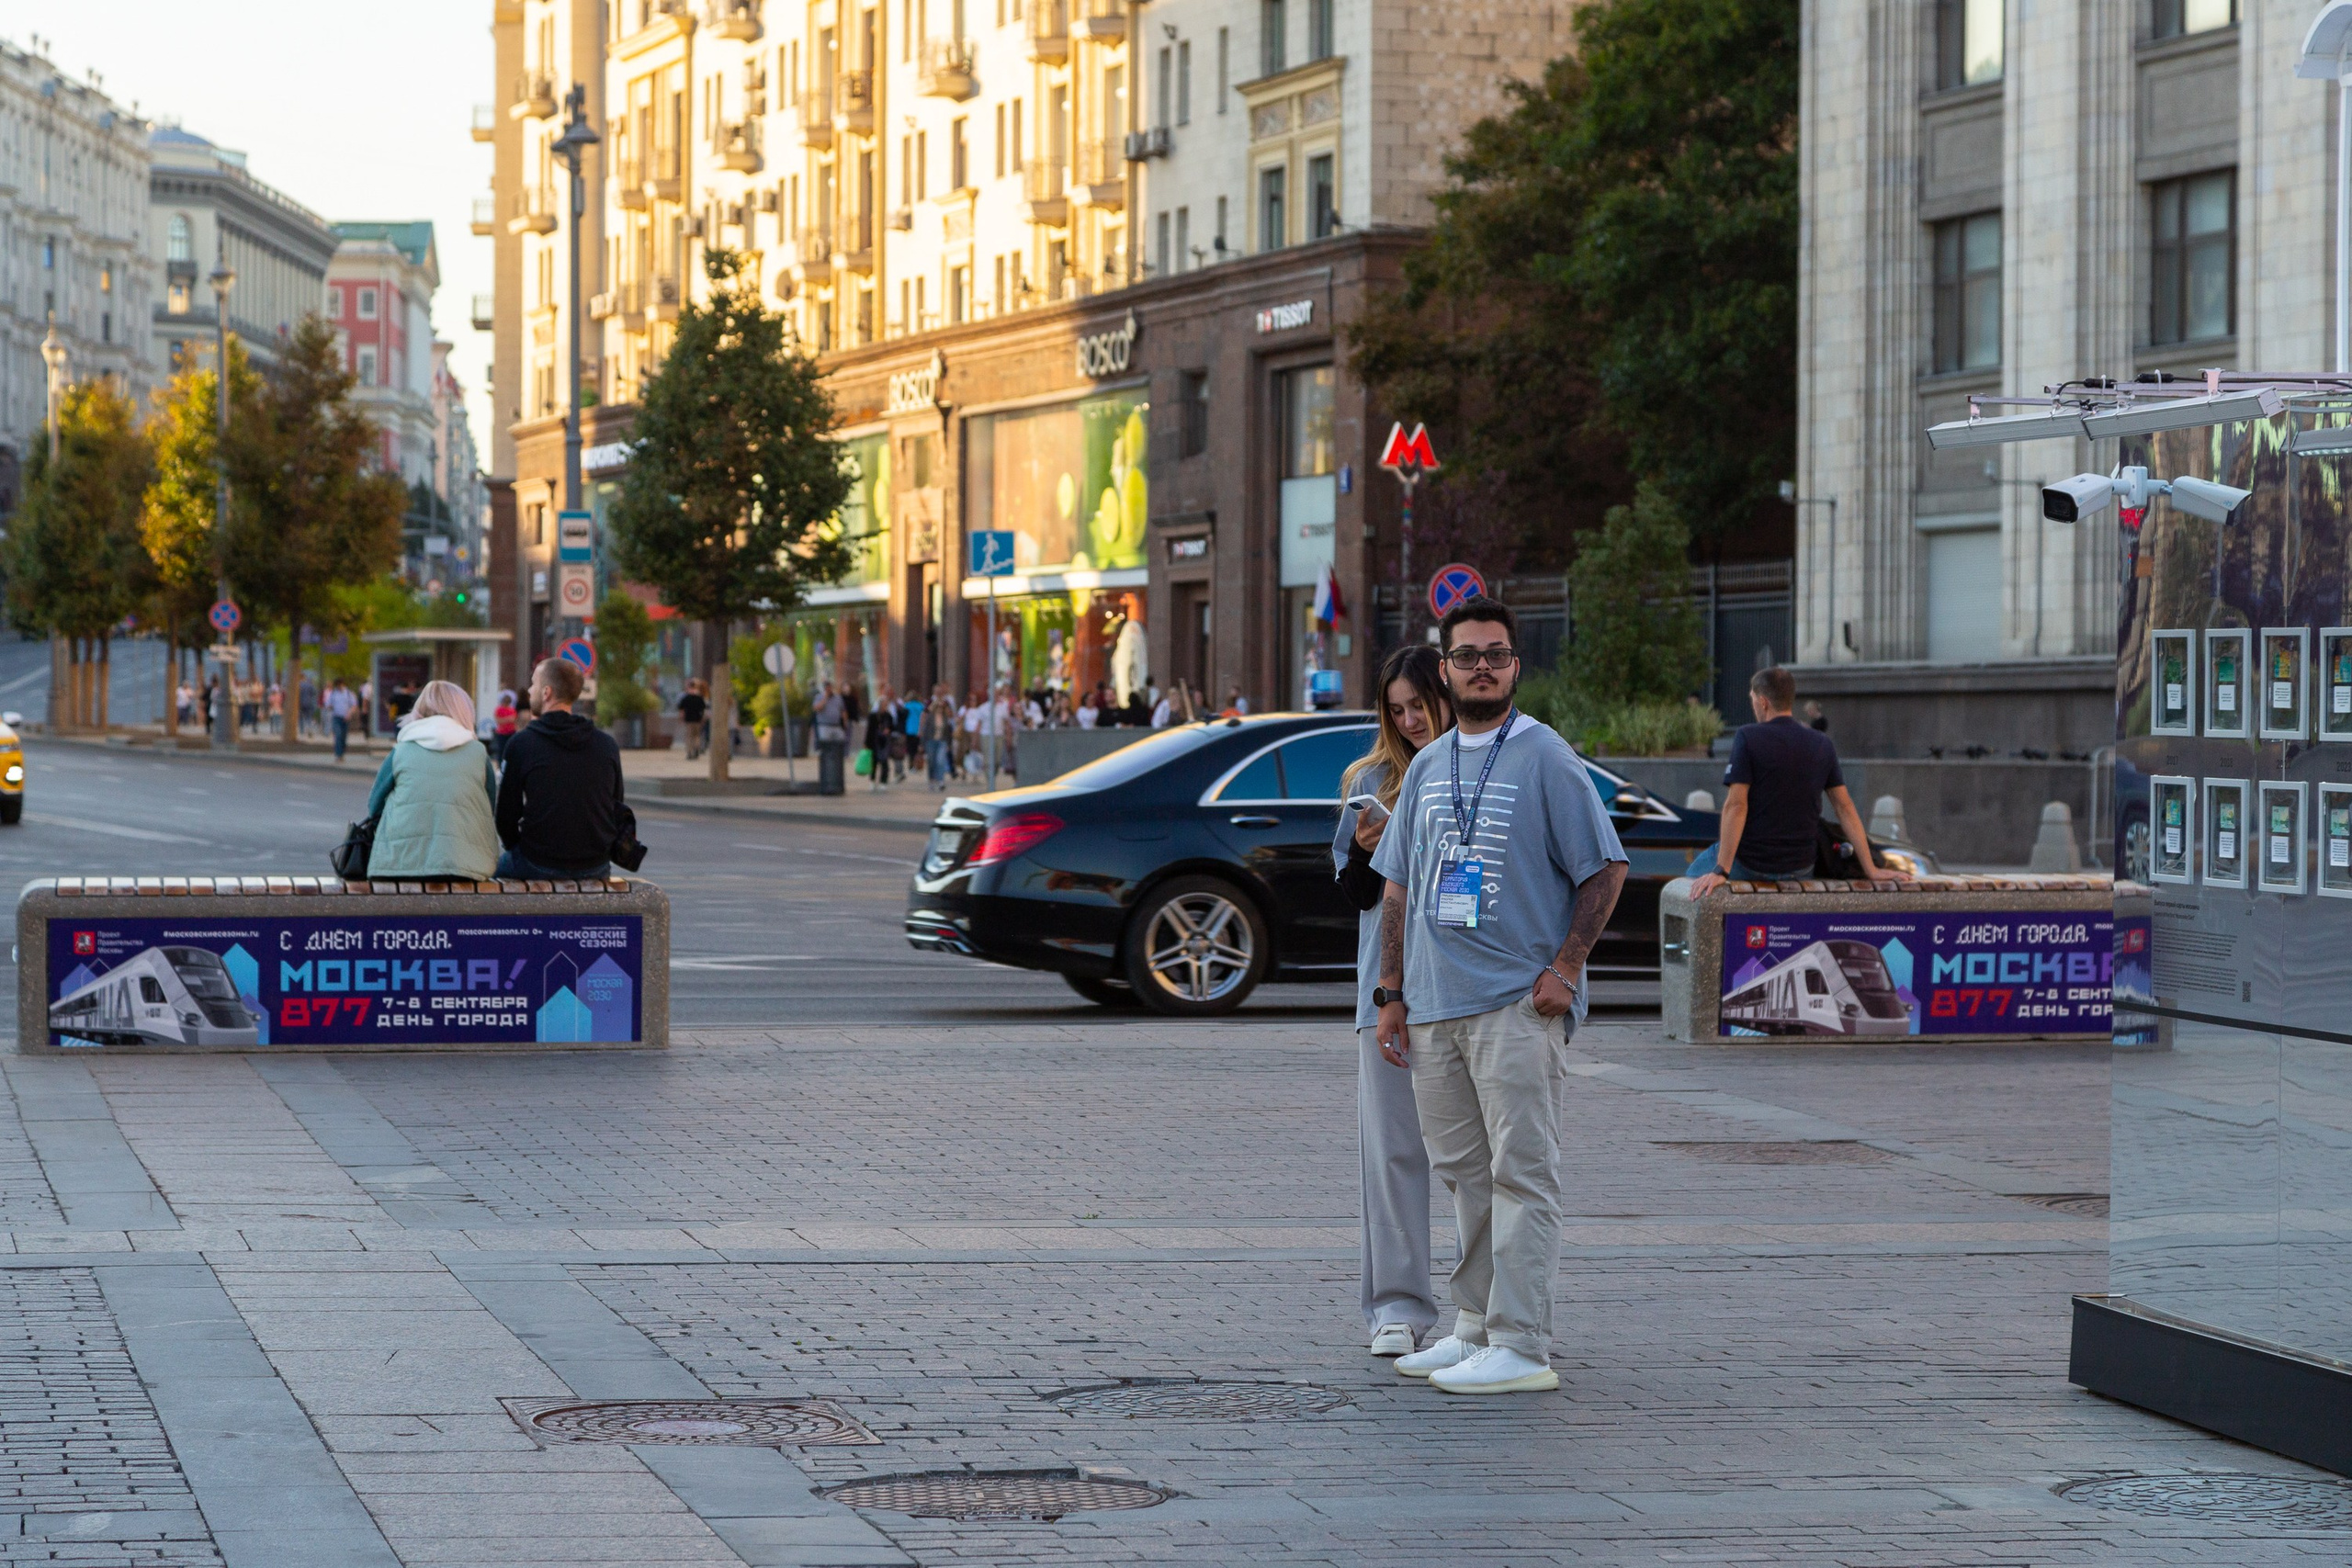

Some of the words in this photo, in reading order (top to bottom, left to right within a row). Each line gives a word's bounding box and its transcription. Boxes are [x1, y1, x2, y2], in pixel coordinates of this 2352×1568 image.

[1272, 299, 1314, 330] TISSOT
[1076, 329, 1130, 378] BOSCO
[2336, 761, 2352, 772] 2023
[458, 928, 529, 936] moscowseasons.ru
[1769, 925, 1791, 933] Проект
[1828, 924, 1916, 932] #московскиесезоны.ru
[1933, 925, 1945, 944] С
[1955, 923, 2008, 944] ДНЁМ
[2017, 923, 2089, 944] ГОРОДА,
[96, 931, 120, 939] Проект
[279, 931, 292, 951] С
[304, 928, 363, 951] ДНЁМ
[549, 931, 627, 940] МОСКОВСКИЕ
[96, 946, 124, 954] Москвы
[579, 939, 627, 948] СЕЗОНЫ
[280, 958, 527, 992] МОСКВА!
[2067, 987, 2113, 1000] СЕНТ
[431, 997, 528, 1009] СЕНТЯБРЯ
[1930, 988, 2014, 1018] 877
[280, 998, 371, 1027] 877
[2017, 1004, 2070, 1018] ДЕНЬ
[377, 1014, 434, 1028] ДЕНЬ
[444, 1014, 528, 1027] ГОРОДА
